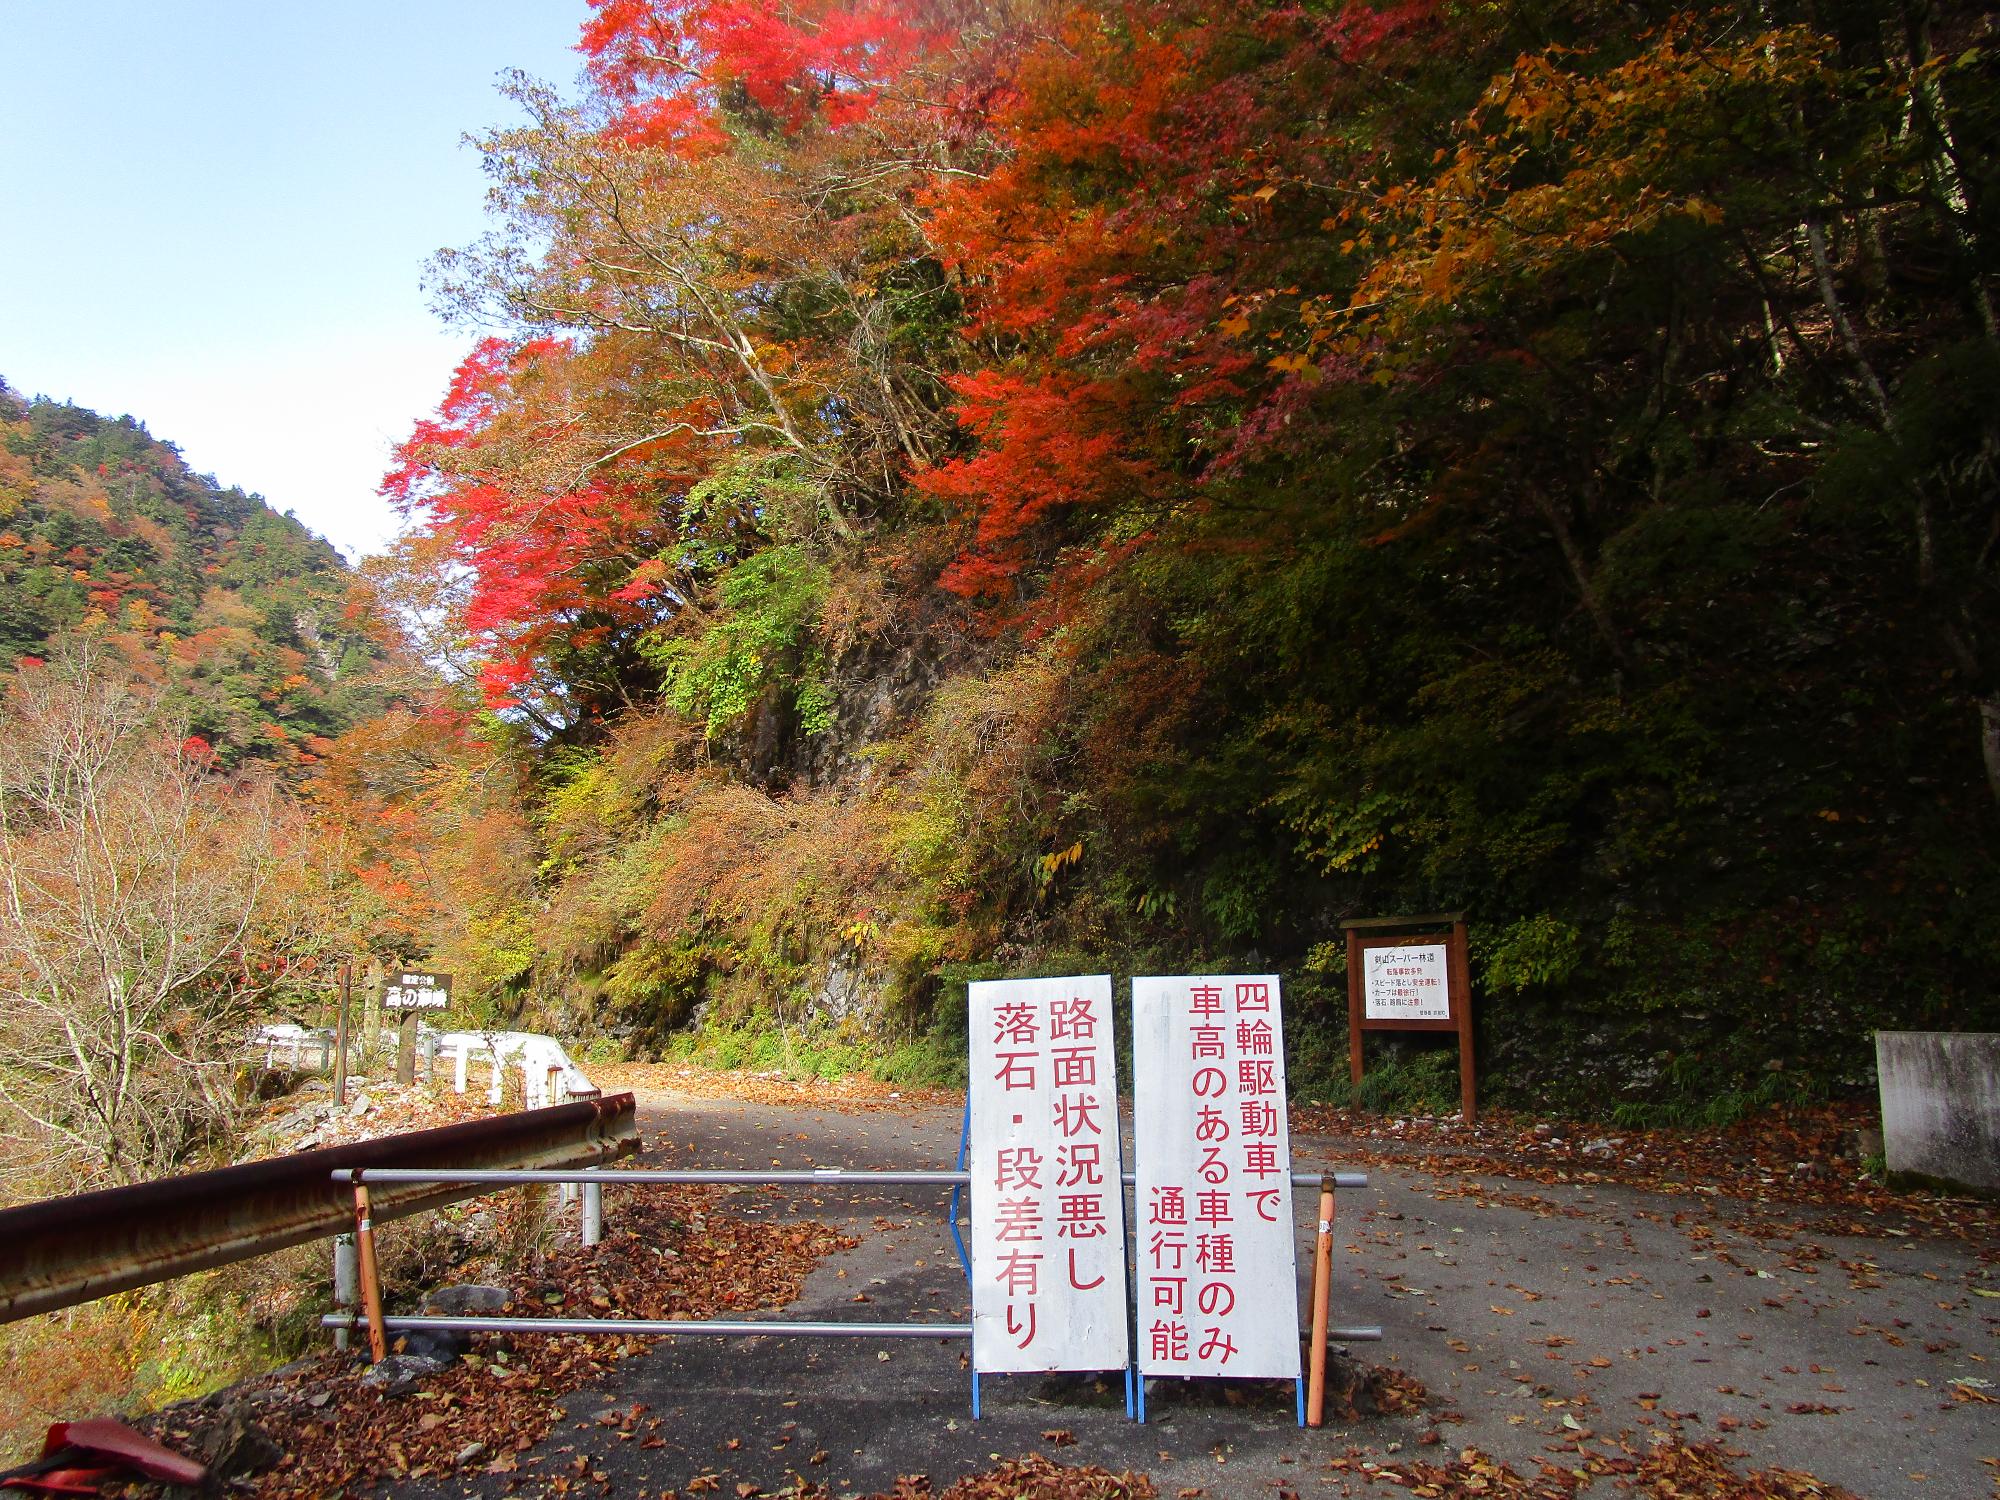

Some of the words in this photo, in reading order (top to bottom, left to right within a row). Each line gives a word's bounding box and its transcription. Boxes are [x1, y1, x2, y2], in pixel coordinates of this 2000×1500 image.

[993, 1002, 1044, 1350] 落石・段差有り
[1049, 998, 1107, 1291] 路面状況悪し
[1189, 984, 1239, 1364] 車高のある車種のみ
[1235, 983, 1282, 1223] 四輪駆動車で
[1149, 1186, 1189, 1362] 通行可能
